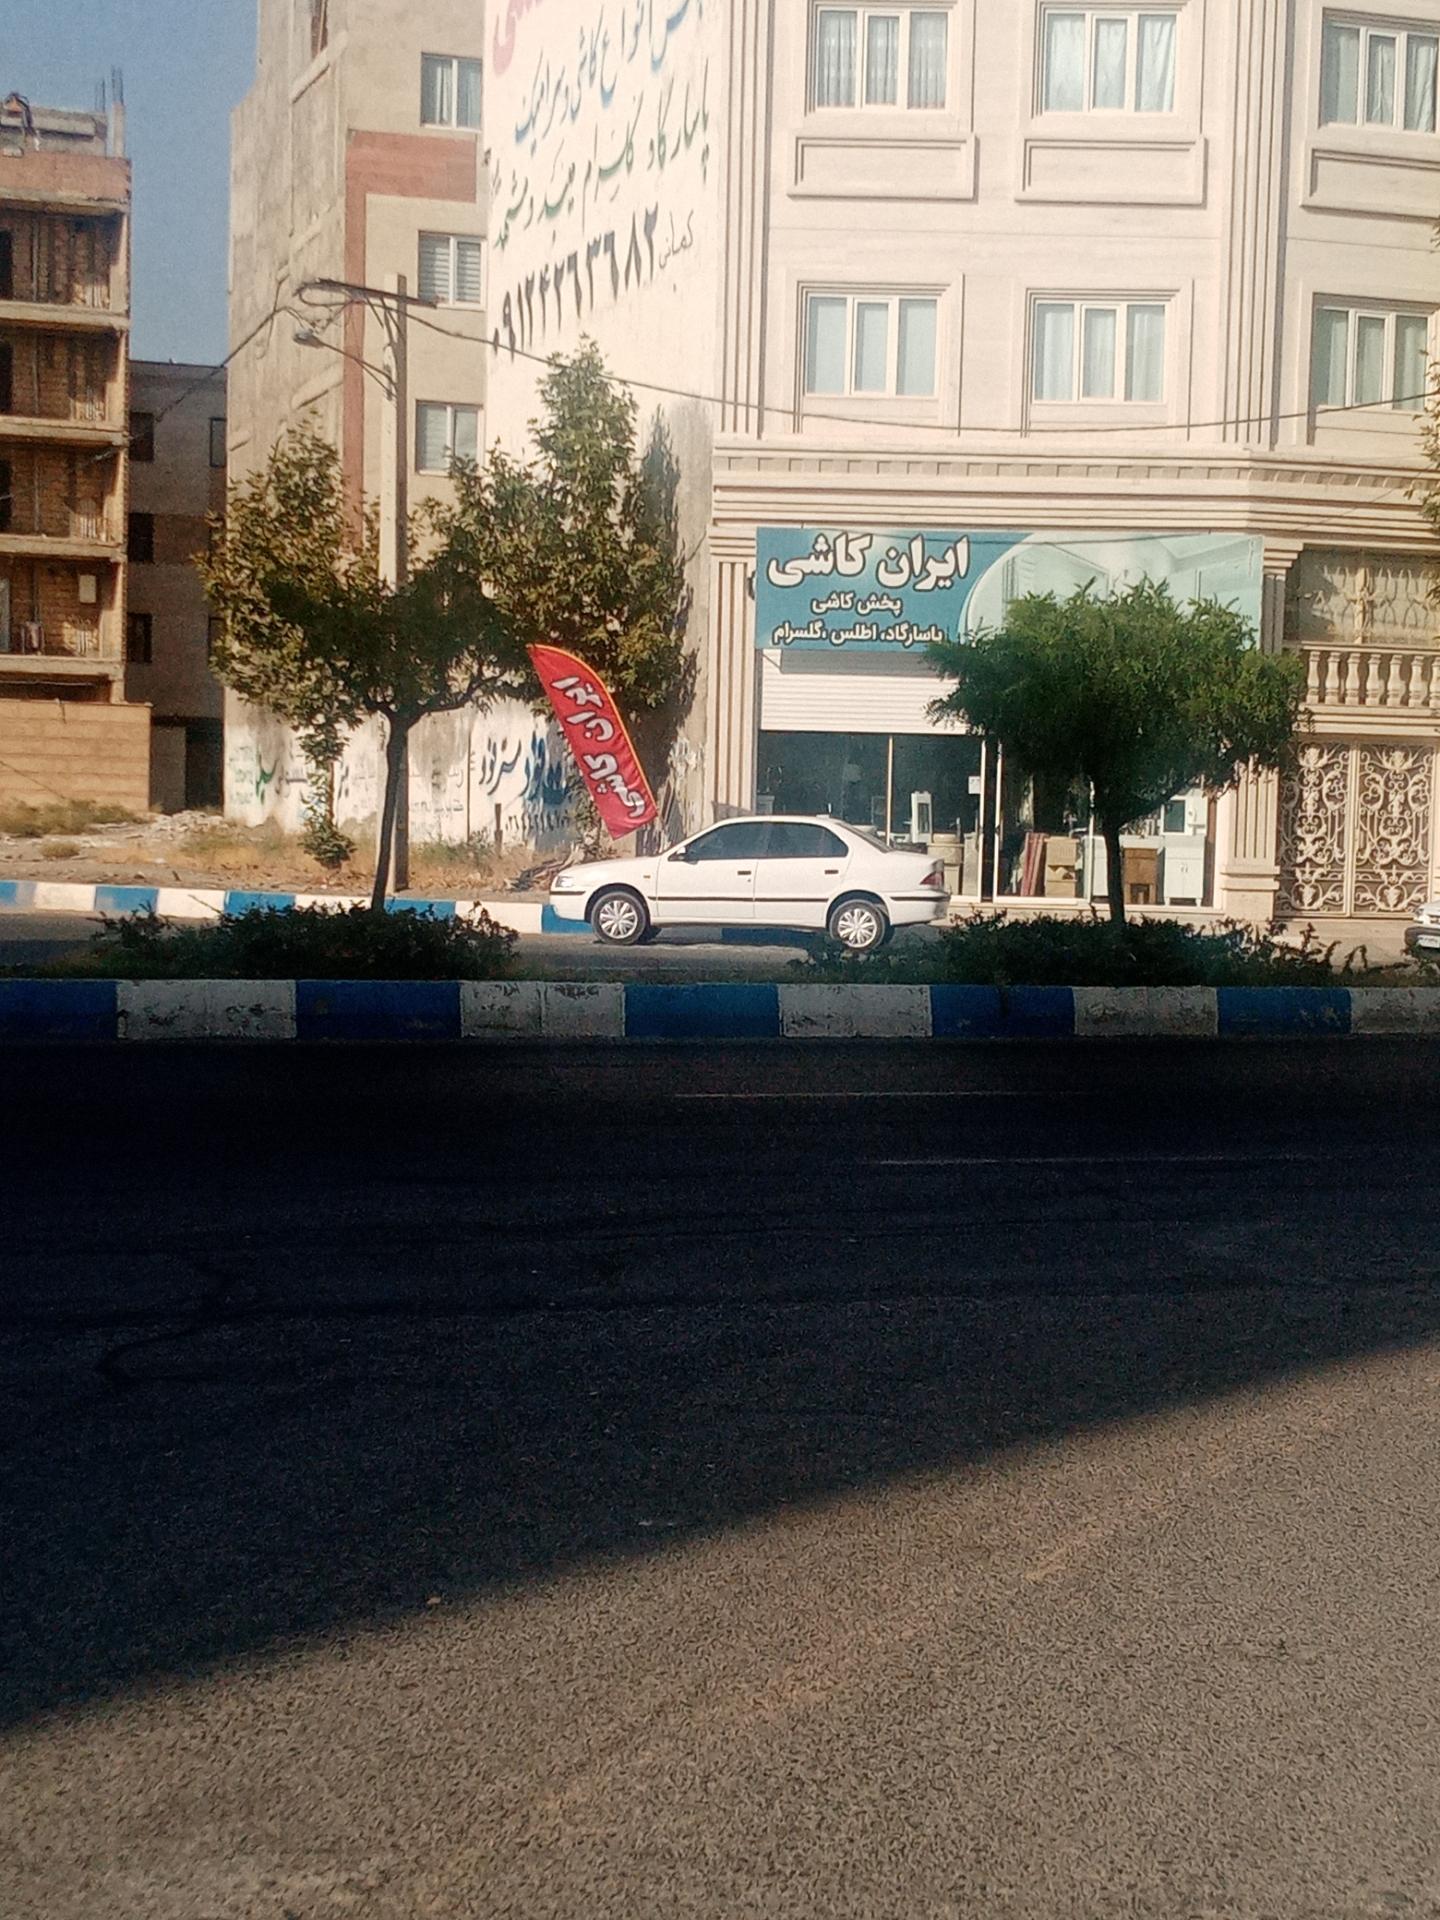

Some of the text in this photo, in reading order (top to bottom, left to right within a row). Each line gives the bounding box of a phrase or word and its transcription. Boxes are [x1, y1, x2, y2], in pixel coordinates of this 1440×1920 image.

[767, 531, 971, 593] ایران کاشی
[811, 590, 904, 617] پخش کاشی
[830, 623, 877, 647] اطلس
[551, 676, 647, 819] ایران کاشی
